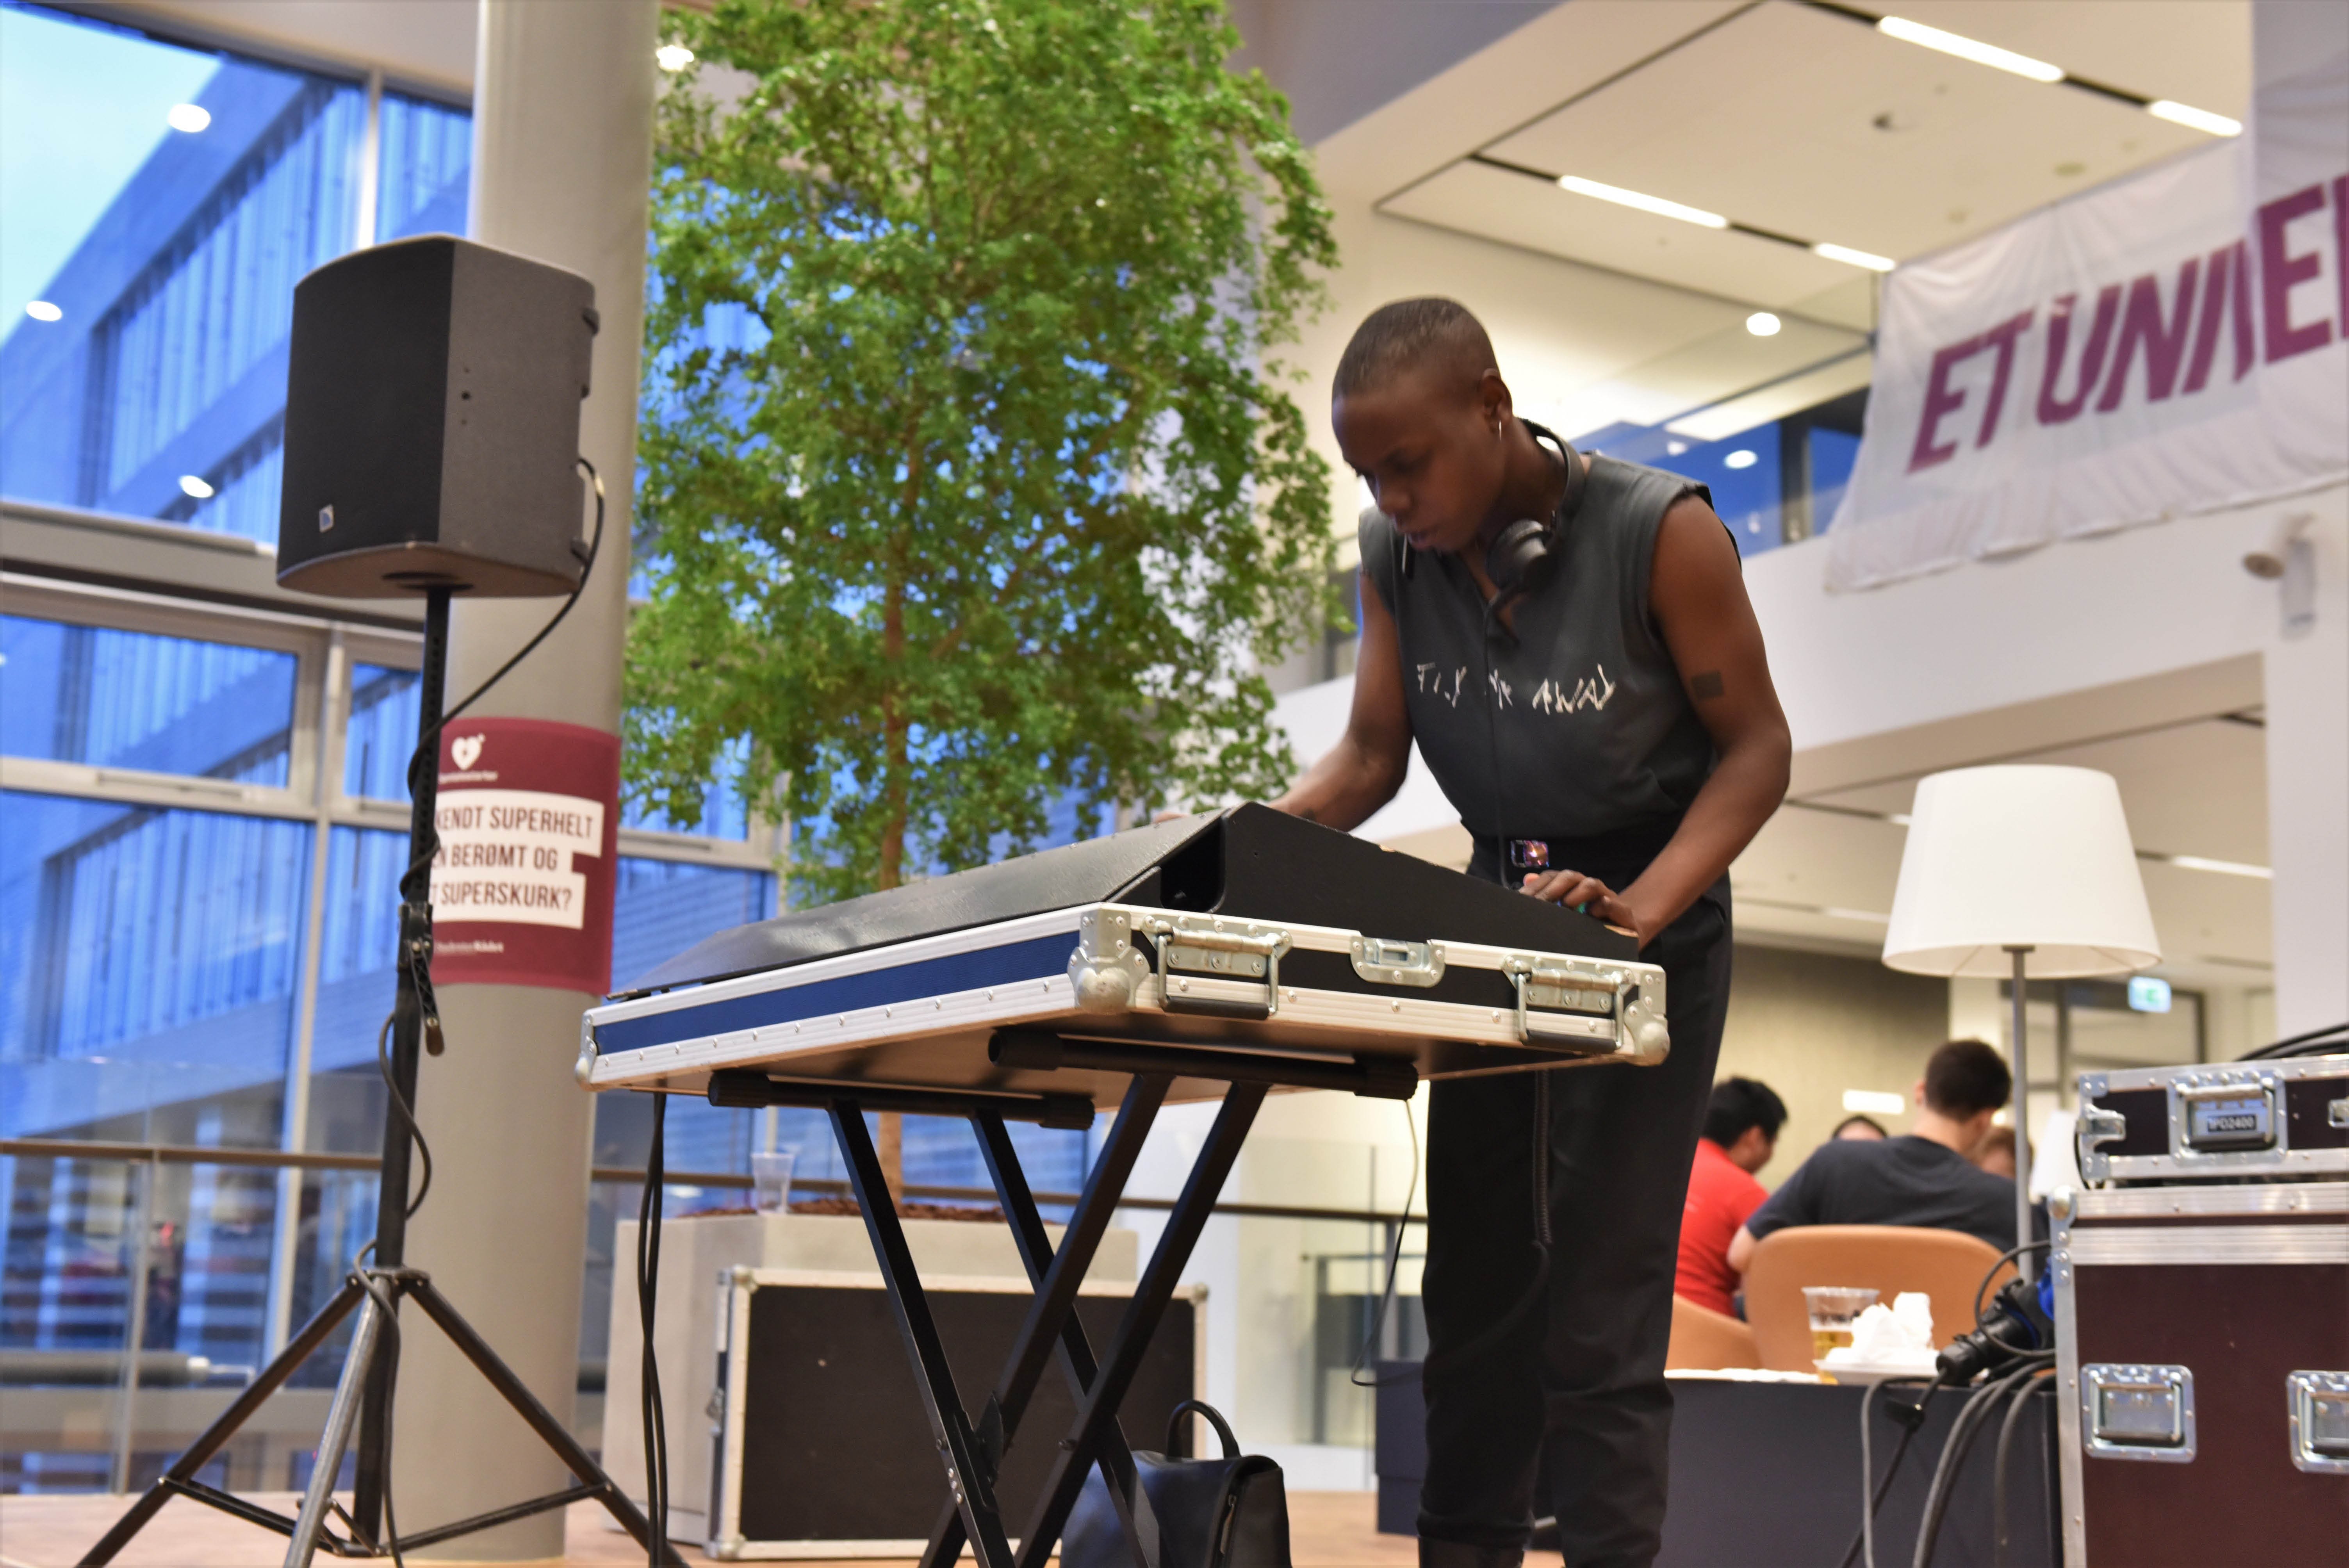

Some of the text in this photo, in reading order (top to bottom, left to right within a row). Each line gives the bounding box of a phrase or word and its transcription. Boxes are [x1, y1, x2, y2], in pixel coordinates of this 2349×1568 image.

[1906, 306, 2035, 474] ET
[490, 805, 593, 839] SUPERHELT
[451, 843, 527, 868] BERØMT
[533, 846, 558, 871] OG
[441, 881, 572, 911] SUPERSKURK?
